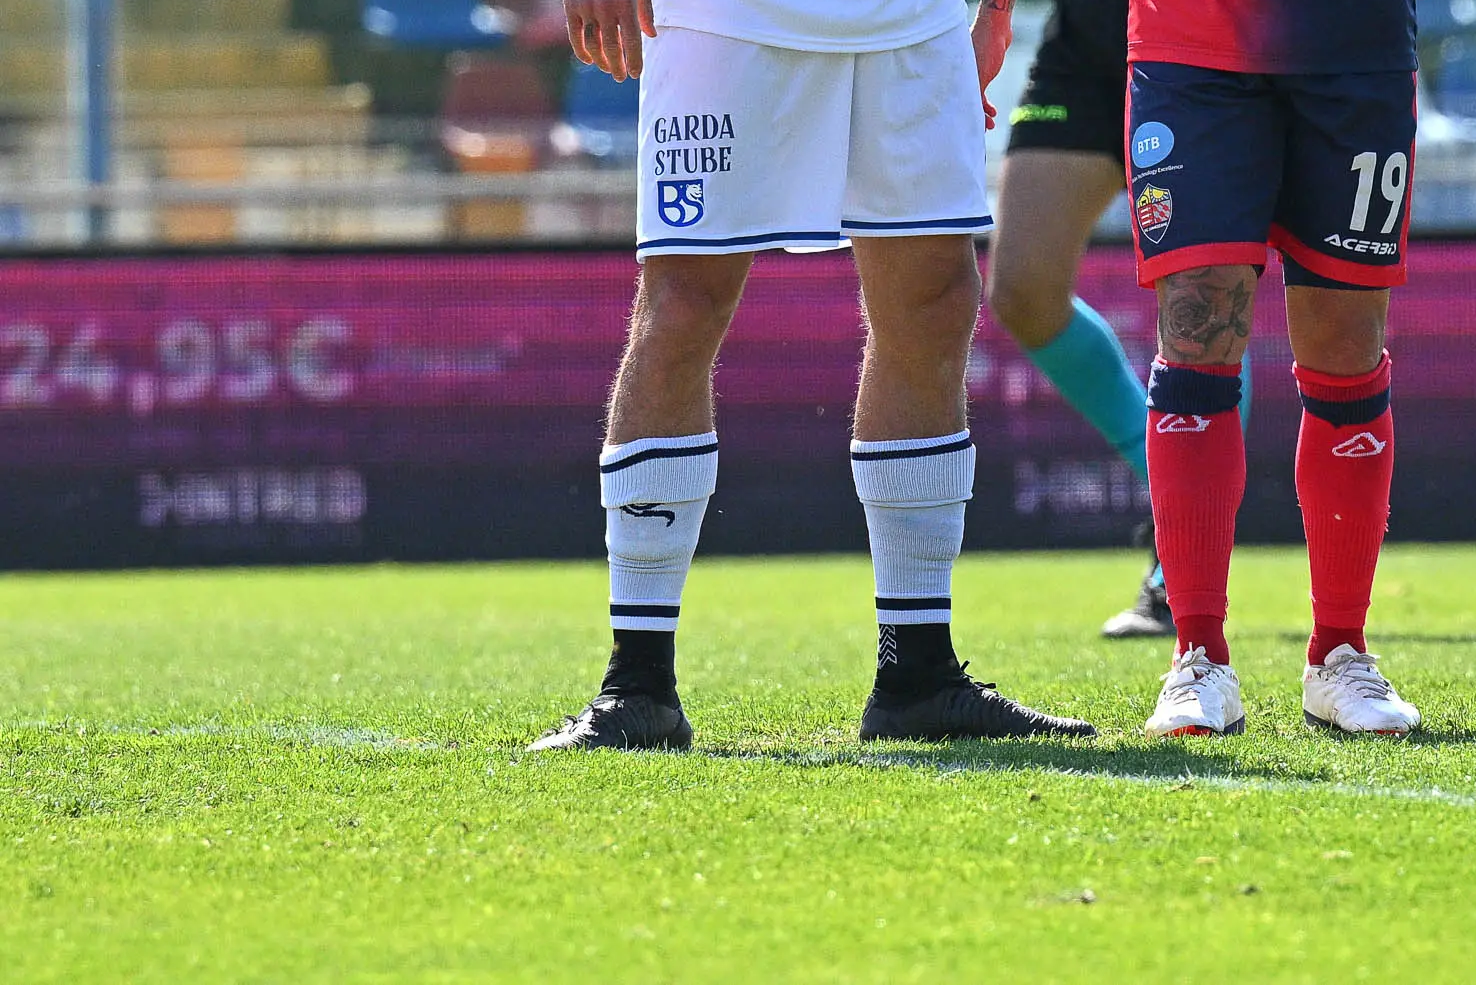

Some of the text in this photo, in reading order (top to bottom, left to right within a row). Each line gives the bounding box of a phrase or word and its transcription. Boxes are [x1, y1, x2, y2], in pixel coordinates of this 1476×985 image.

[655, 114, 735, 144] GARDA
[1137, 136, 1160, 154] BTB
[655, 147, 732, 176] STUBE
[1349, 151, 1407, 234] 19
